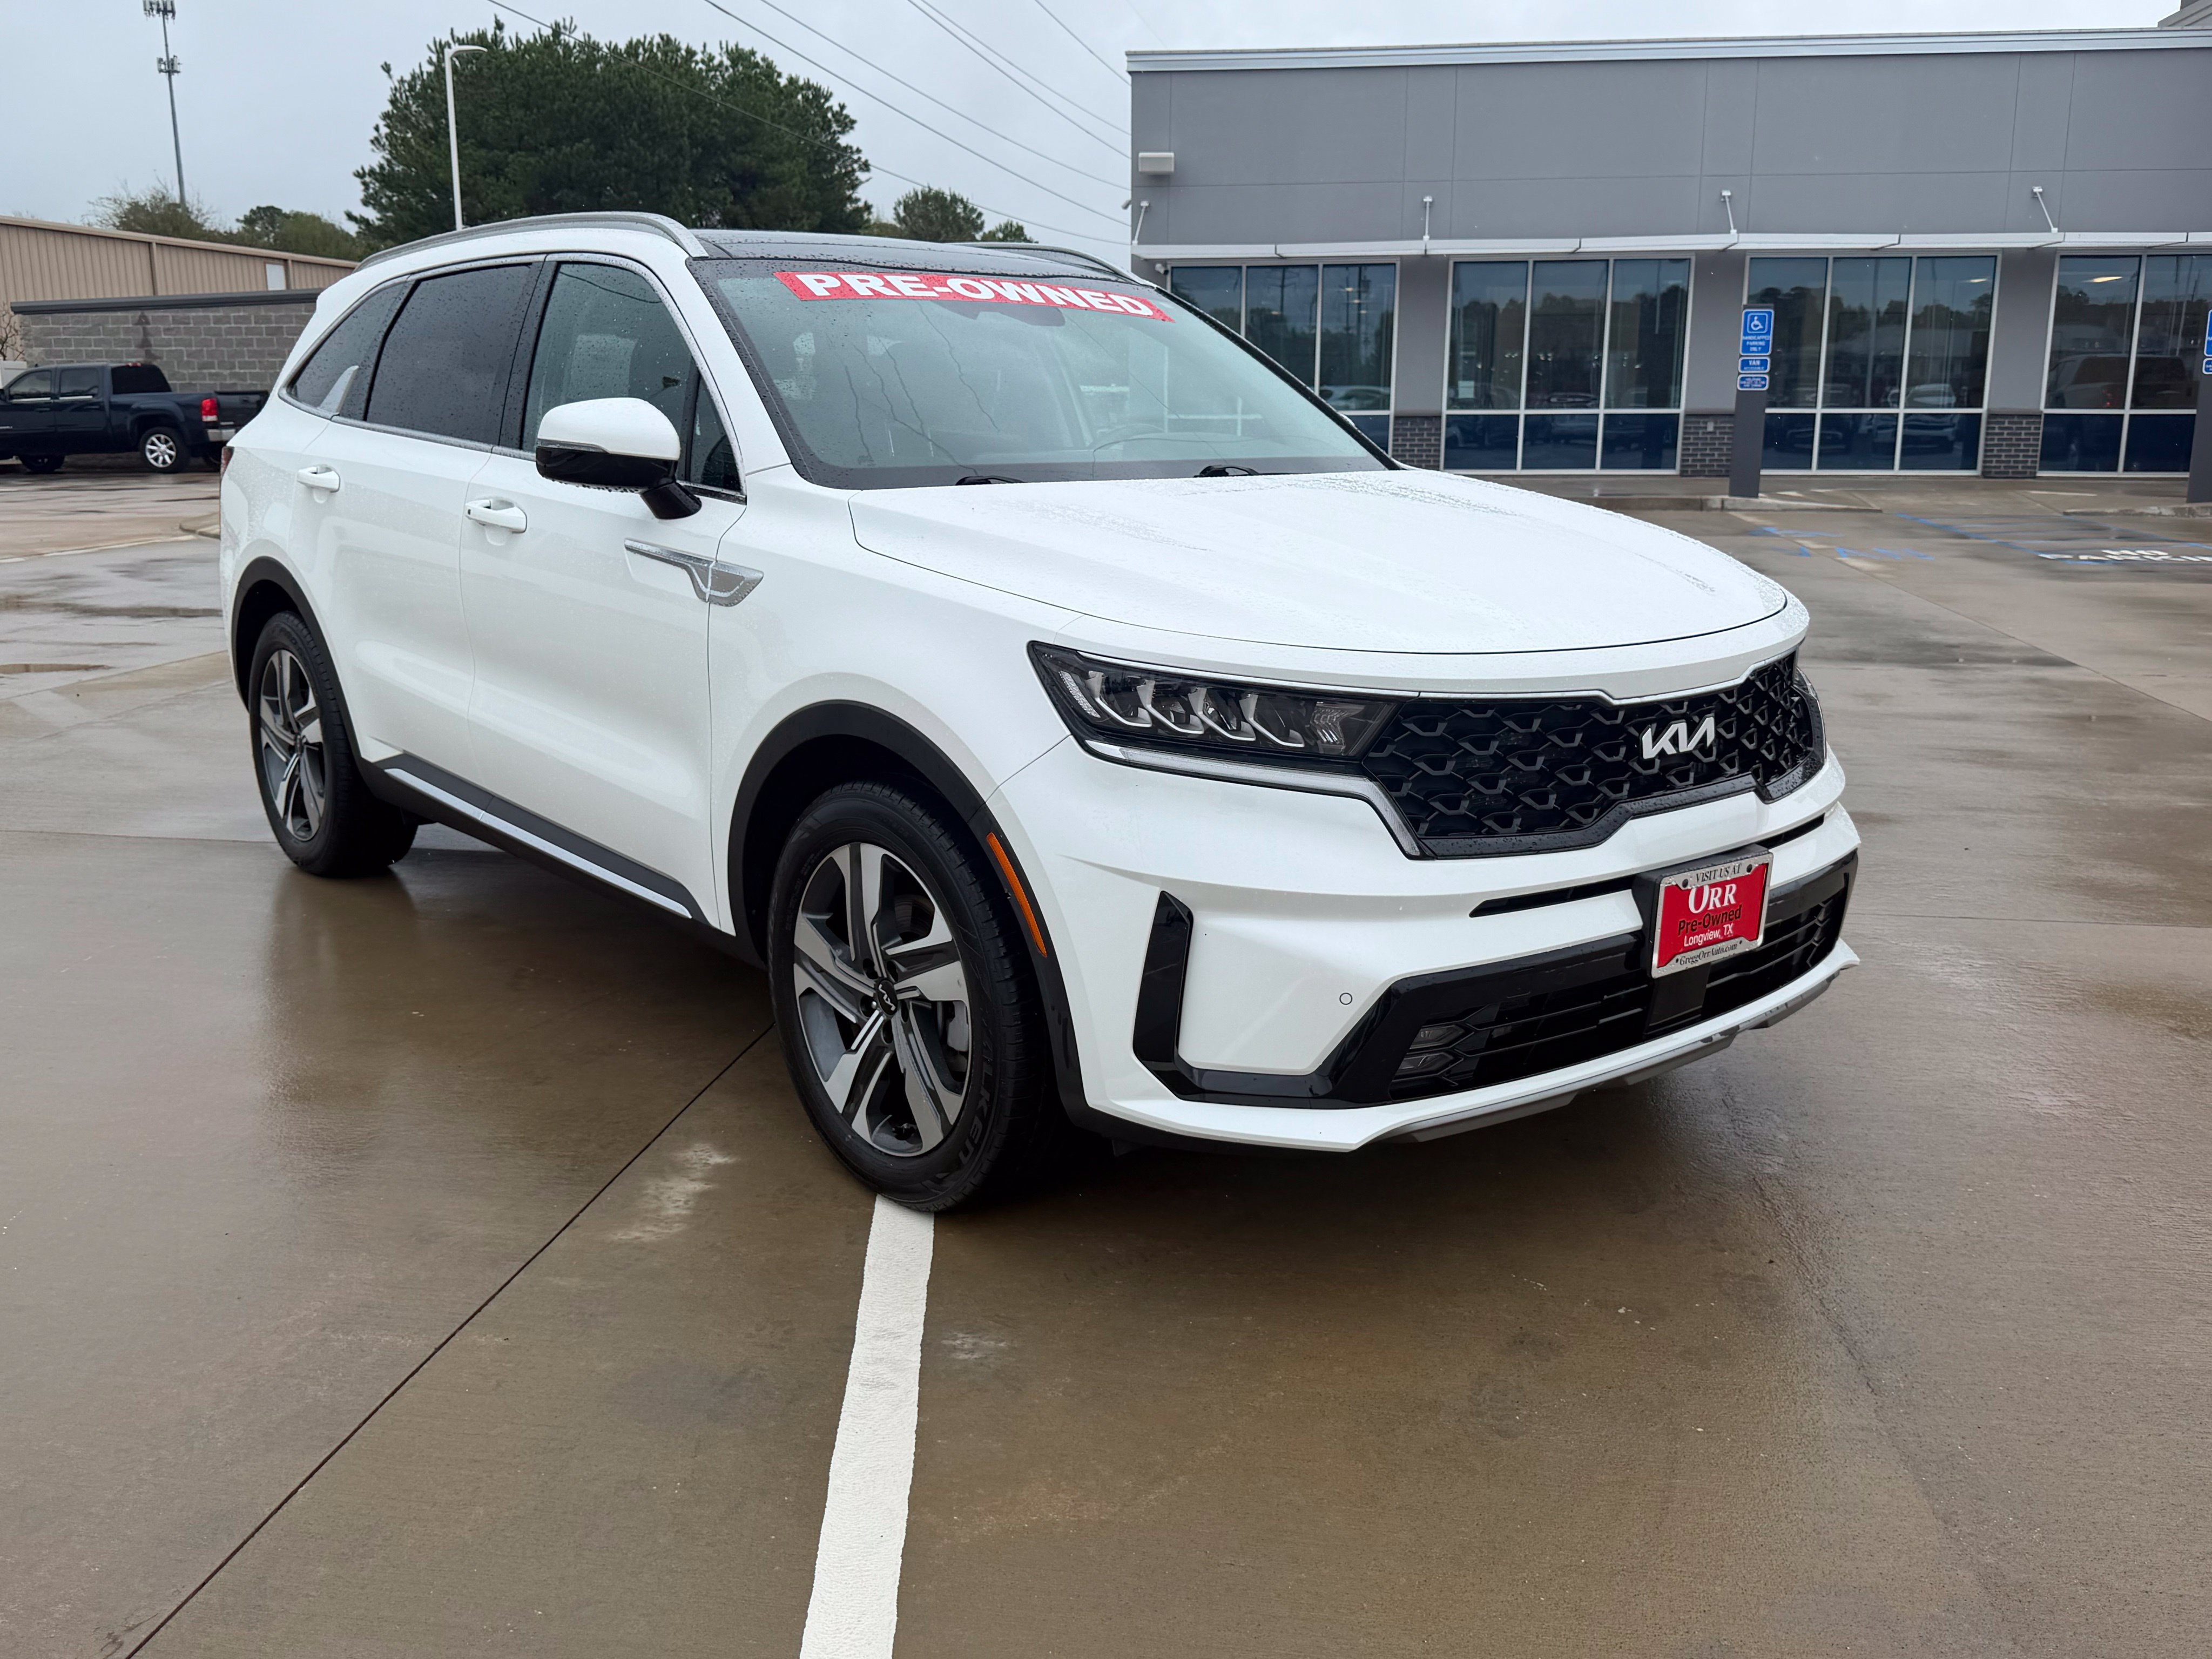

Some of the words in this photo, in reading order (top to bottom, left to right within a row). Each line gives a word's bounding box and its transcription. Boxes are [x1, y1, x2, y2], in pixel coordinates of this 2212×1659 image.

[795, 273, 1154, 316] PRE-OWNED
[1642, 717, 1715, 759] KIA
[1696, 869, 1718, 883] VISIT
[1719, 866, 1730, 878] US
[1731, 863, 1742, 875] AT
[1688, 884, 1737, 913] ORR
[1678, 904, 1742, 935] Pre-Owned
[1684, 928, 1722, 947] Longview,
[1723, 922, 1734, 936] TX
[1680, 943, 1737, 966] GreggOrrAuto.com
